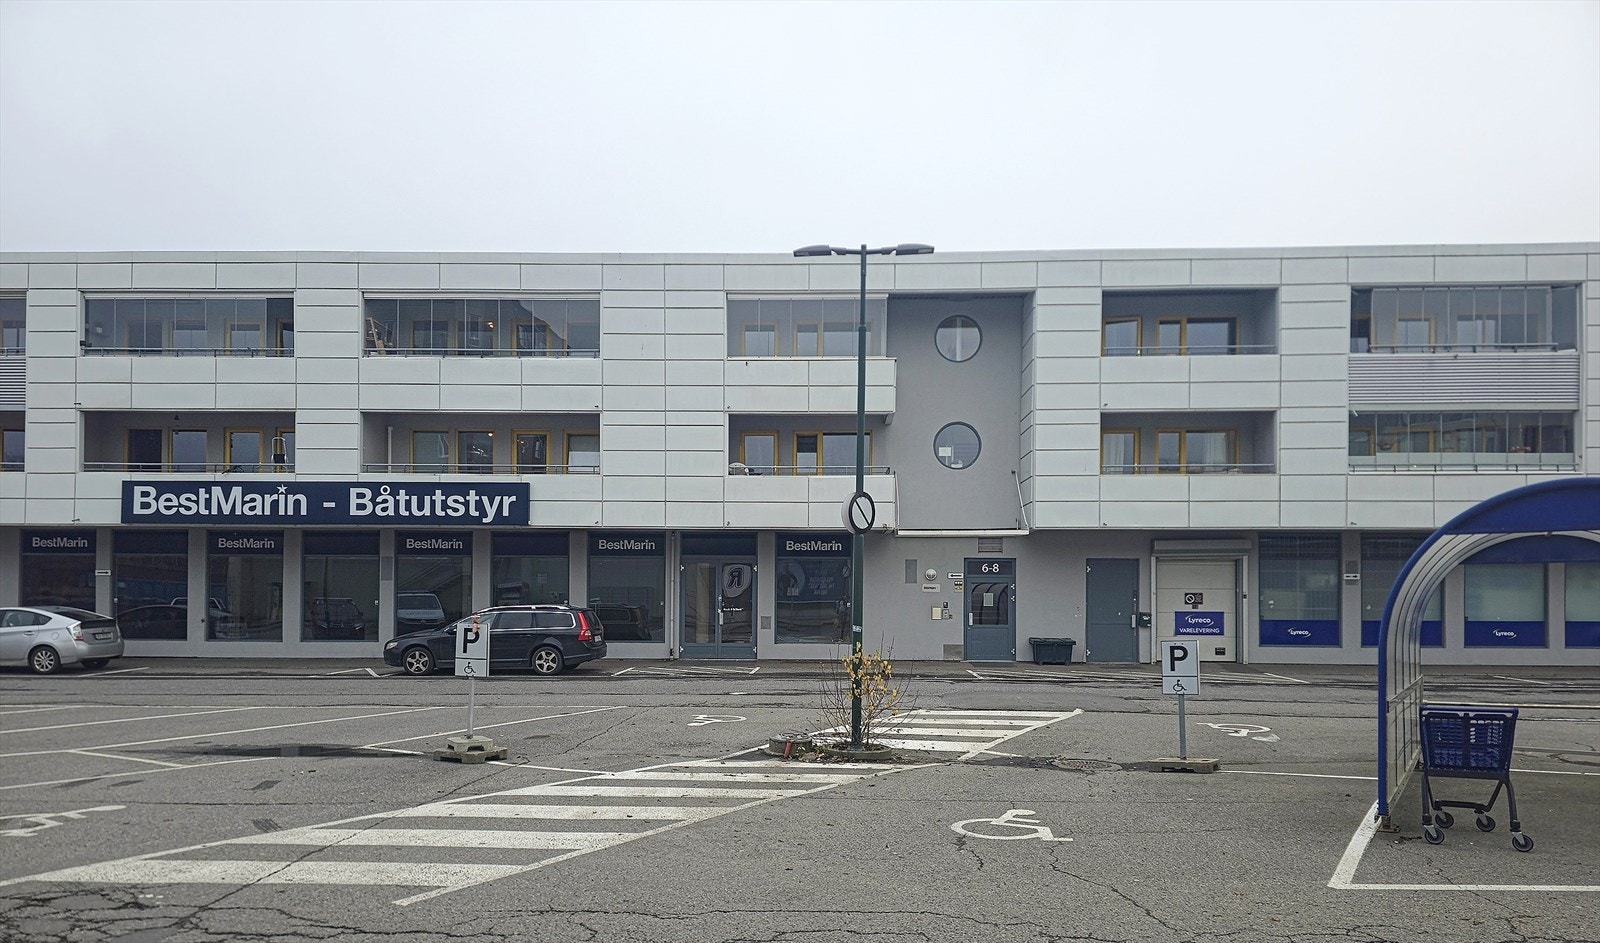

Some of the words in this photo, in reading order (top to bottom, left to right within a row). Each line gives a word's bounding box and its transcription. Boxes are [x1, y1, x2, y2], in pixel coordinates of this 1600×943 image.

[133, 485, 307, 516] BestMarin
[349, 485, 517, 523] Båtutstyr
[32, 537, 88, 548] BestMarin
[218, 538, 275, 549] BestMarin
[406, 538, 463, 550] BestMarin
[598, 539, 656, 551] BestMarin
[786, 540, 843, 551] BestMarin
[981, 563, 1000, 573] 6-8
[1188, 616, 1211, 625] Lyreco
[462, 627, 480, 654] P
[1169, 645, 1189, 672] P
